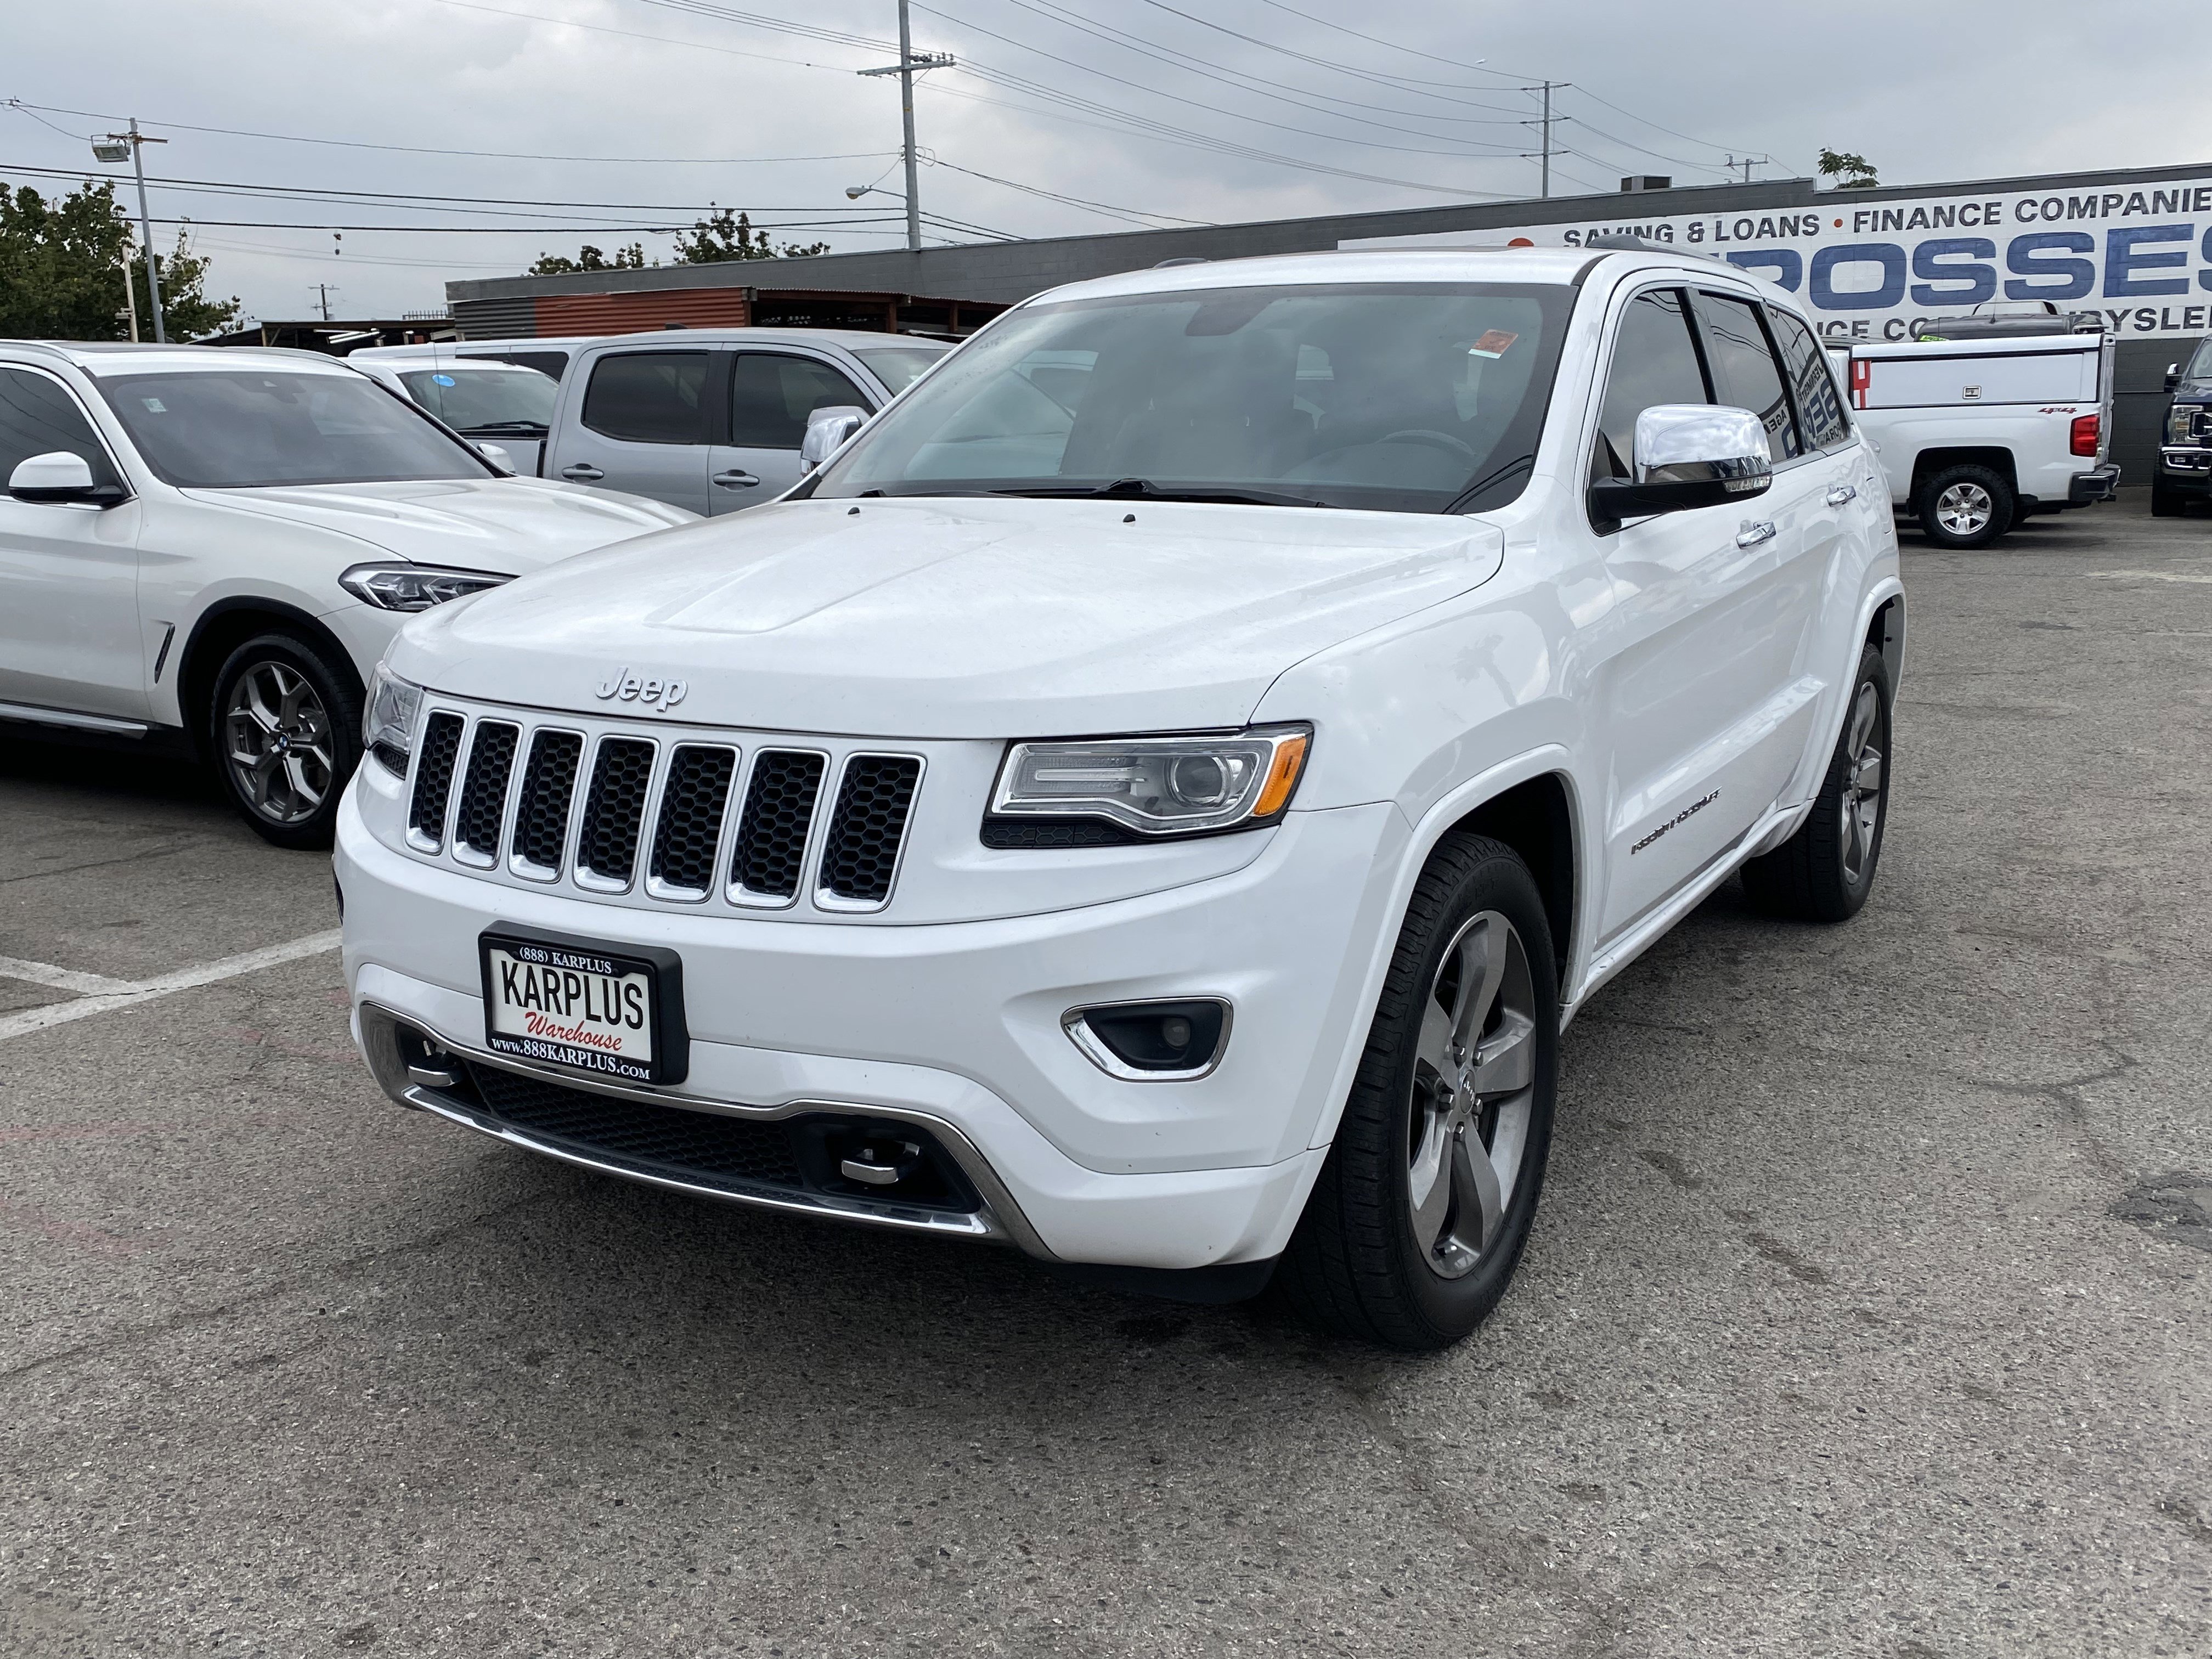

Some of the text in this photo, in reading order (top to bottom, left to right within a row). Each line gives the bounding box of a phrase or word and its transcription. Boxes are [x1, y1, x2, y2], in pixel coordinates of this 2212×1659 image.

[1687, 222, 1705, 242] &
[1715, 214, 1820, 242] LOANS
[1854, 202, 2002, 233] FINANCE
[1726, 223, 2212, 310] POSSE
[595, 667, 688, 713] Jeep
[519, 946, 612, 974] (888) KARPLUS
[500, 960, 644, 1030] KARPLUS
[524, 1011, 623, 1051] Warehouse
